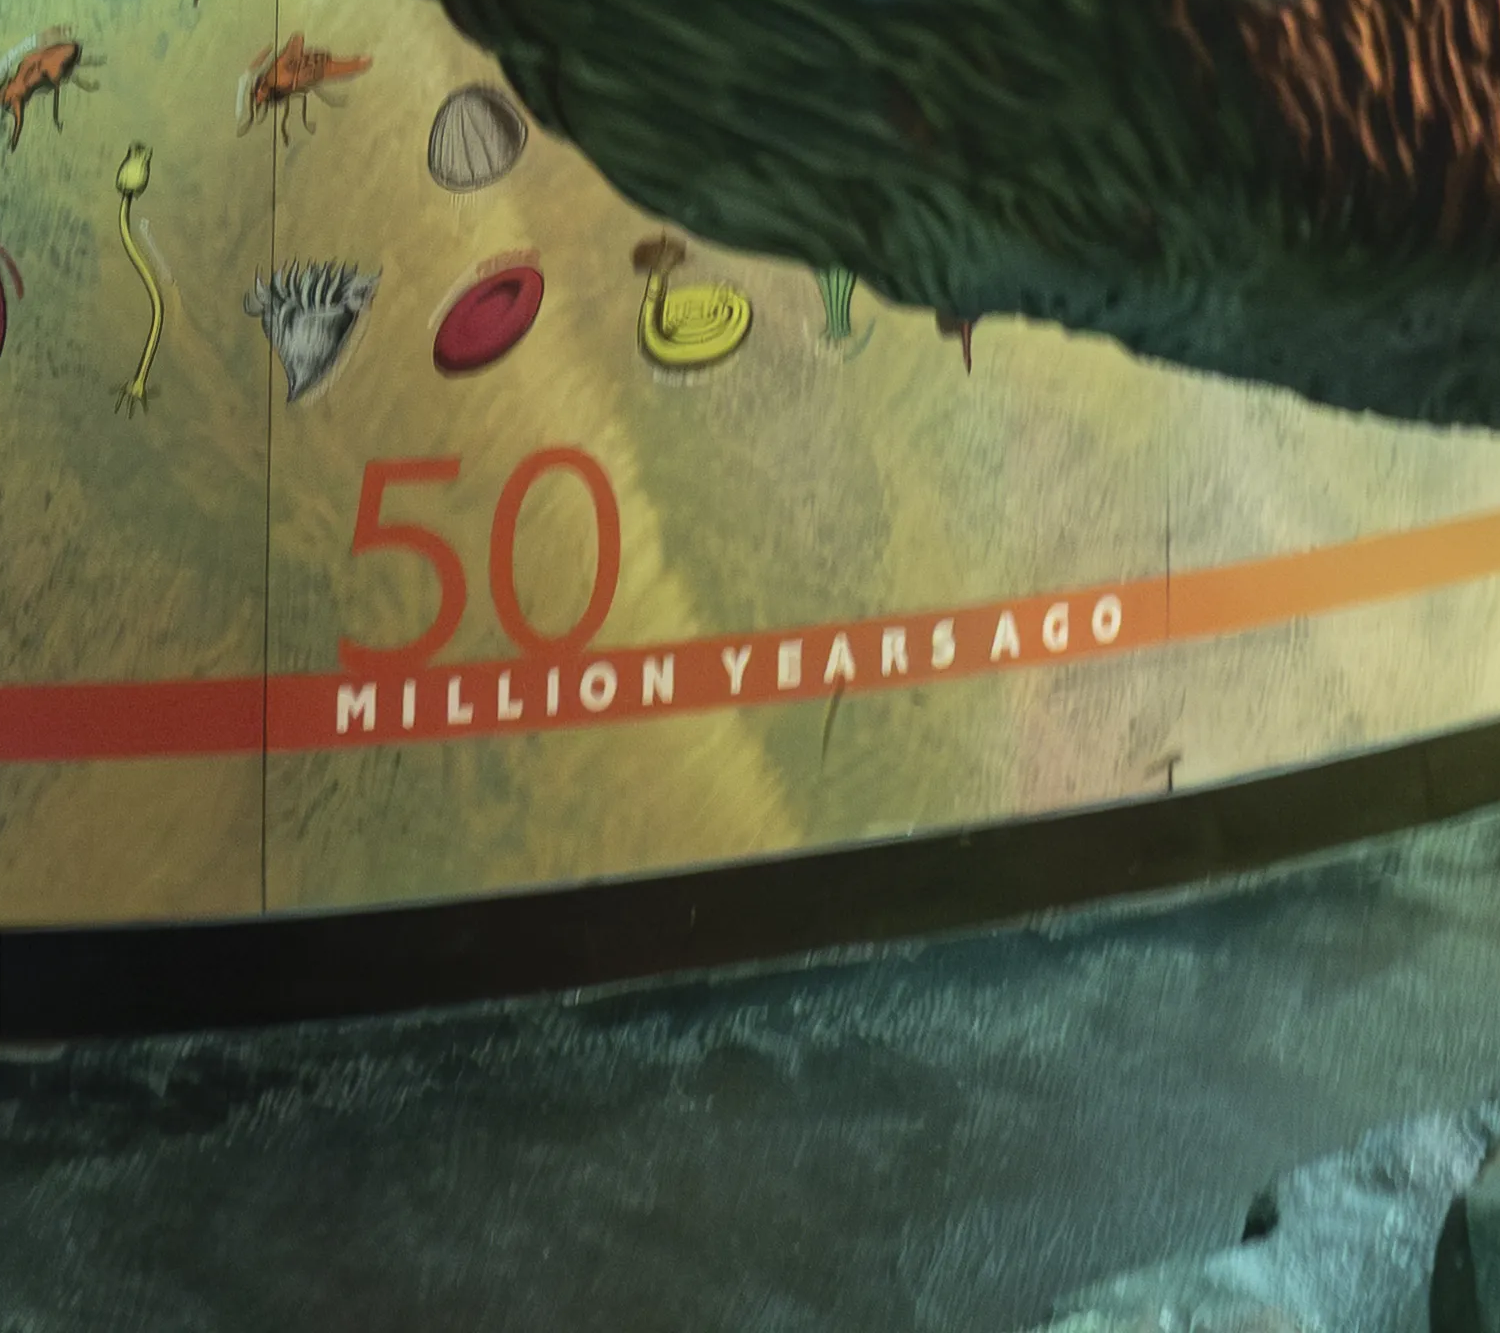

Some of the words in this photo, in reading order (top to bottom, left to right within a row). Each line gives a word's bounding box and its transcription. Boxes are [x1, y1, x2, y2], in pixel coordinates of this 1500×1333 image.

[337, 445, 621, 675] 50
[336, 652, 676, 735] MILLION
[721, 616, 956, 695] YEARS
[990, 593, 1123, 662] AGO
